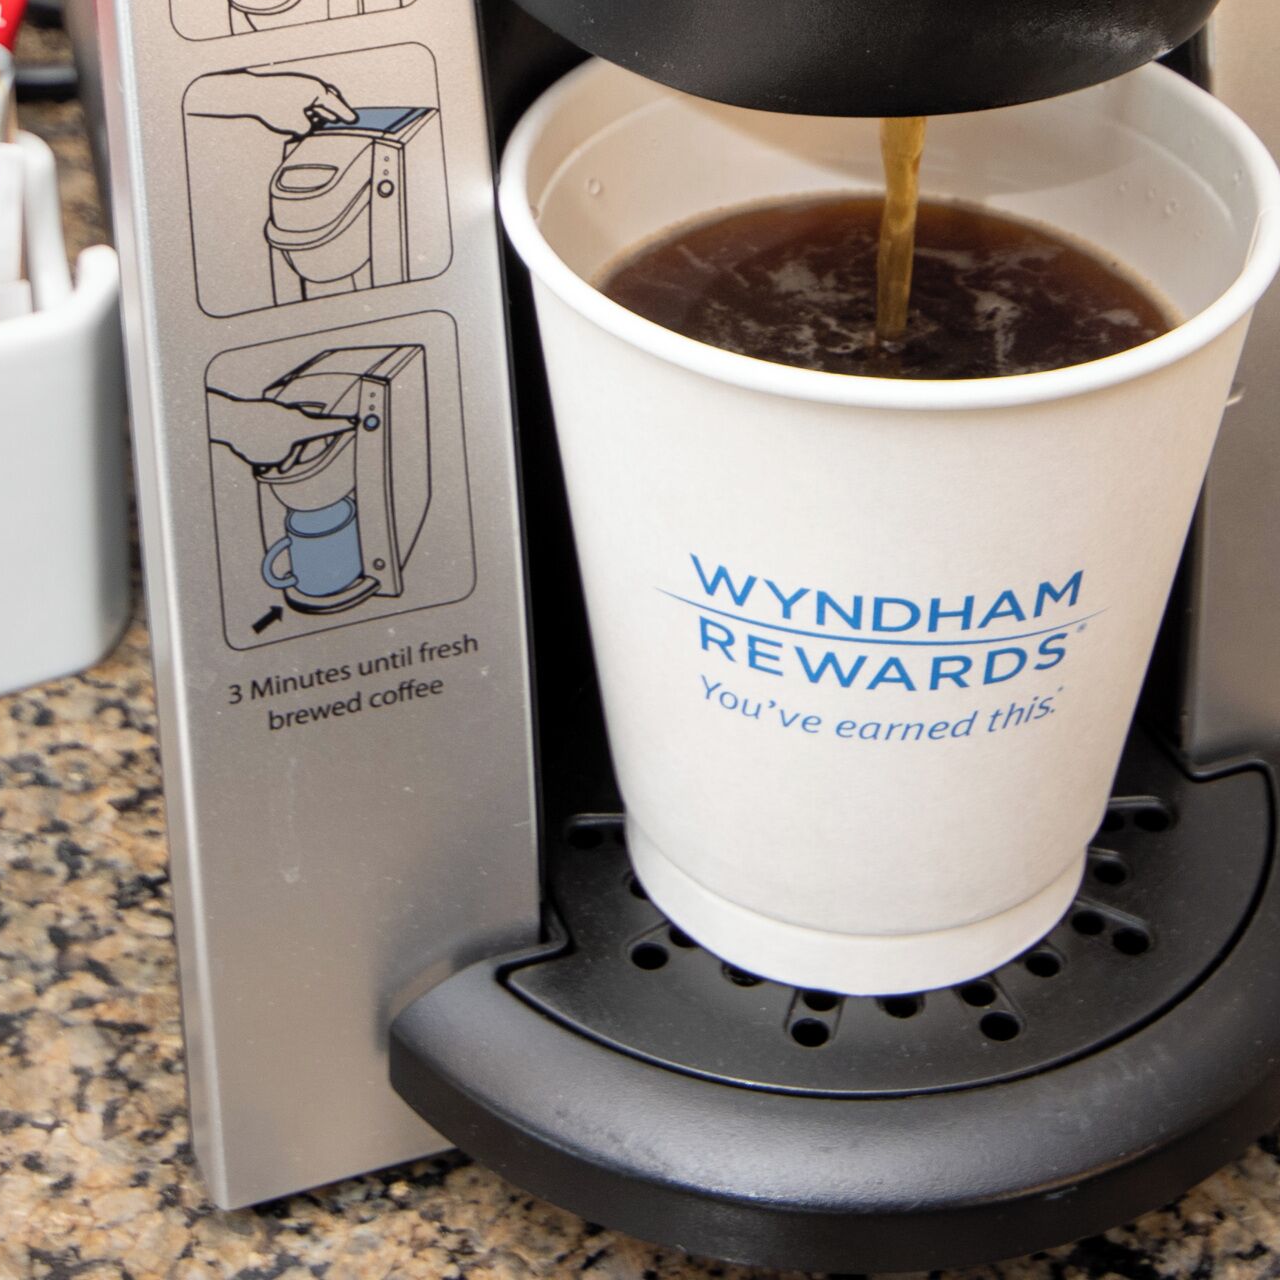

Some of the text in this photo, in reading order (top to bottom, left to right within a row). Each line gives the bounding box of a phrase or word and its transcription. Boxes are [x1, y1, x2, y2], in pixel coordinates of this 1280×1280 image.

[689, 552, 1085, 632] WYNDHAM
[227, 633, 479, 704] 3 Minutes until fresh
[267, 678, 444, 731] brewed coffee
[699, 673, 822, 734] You've
[834, 709, 979, 741] earned
